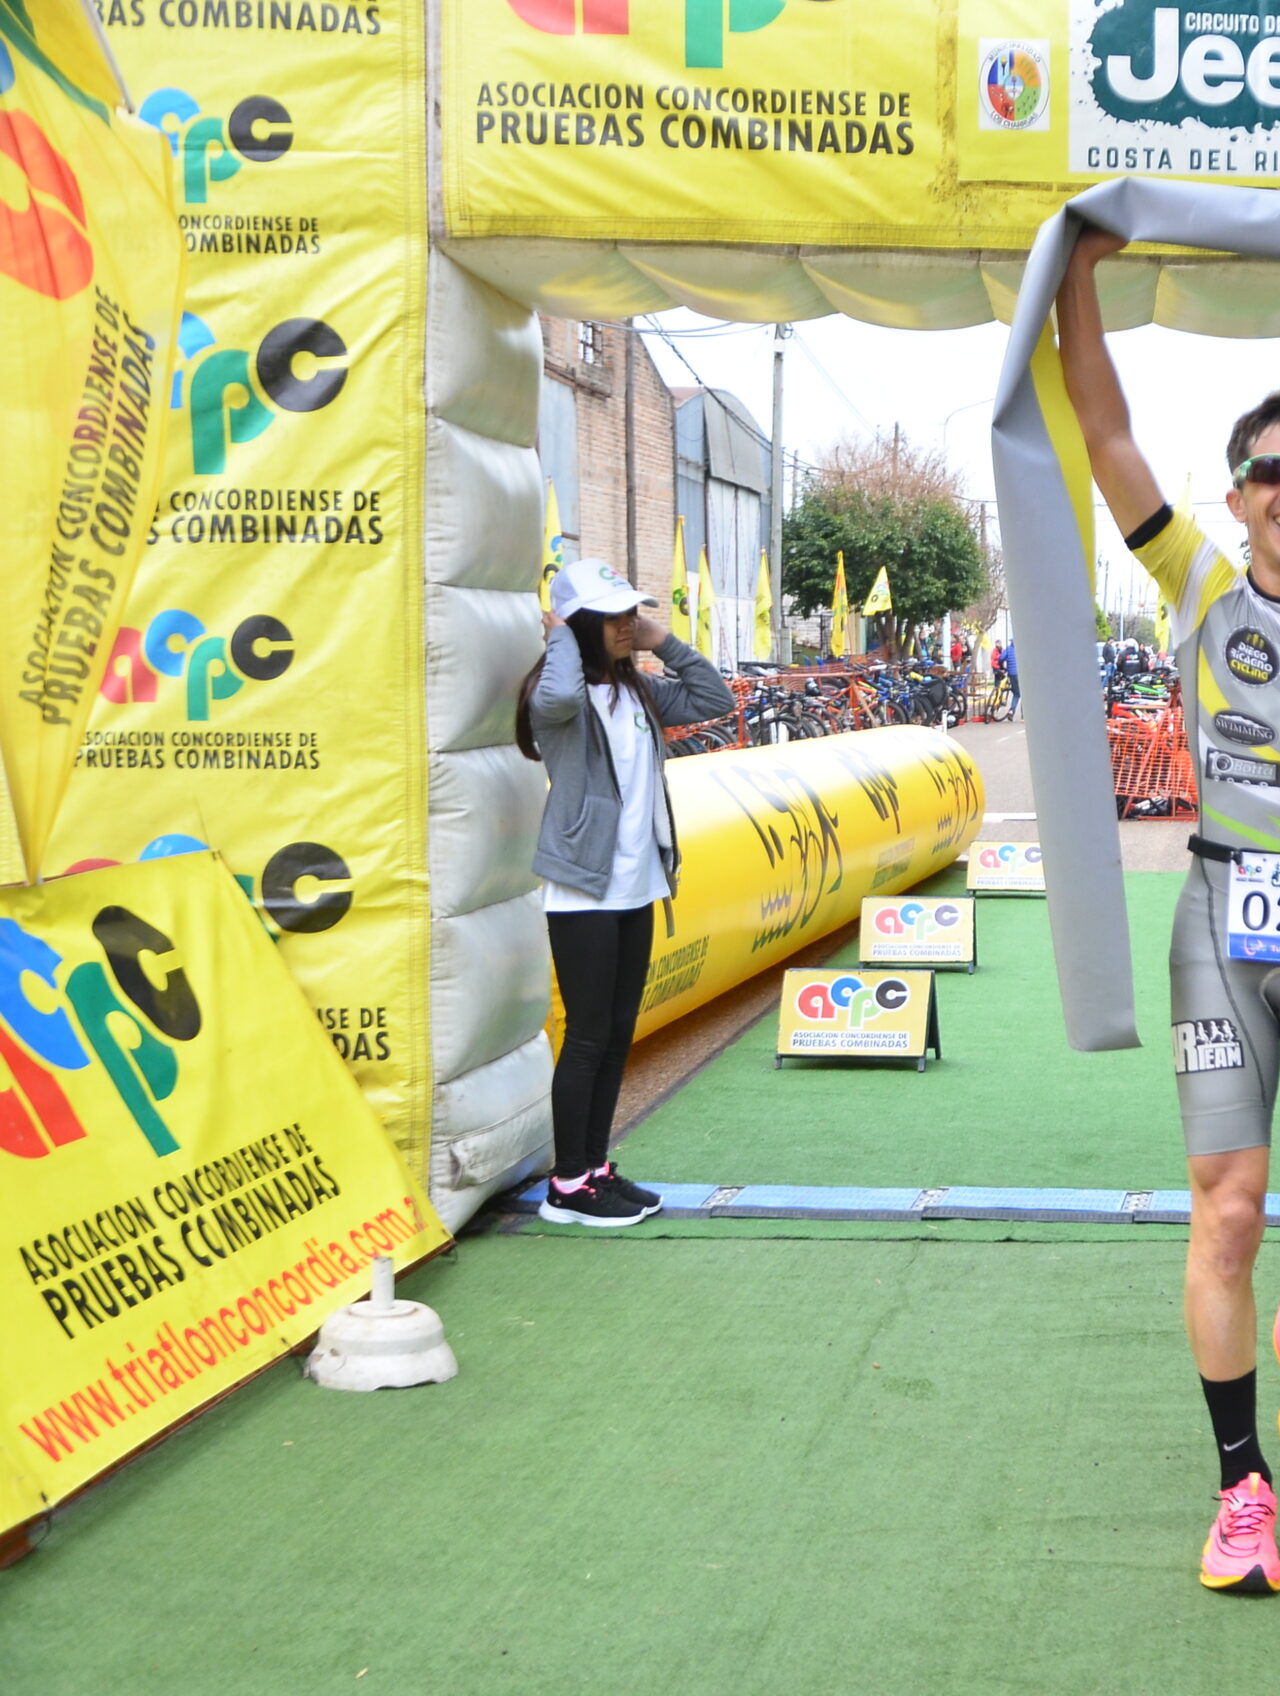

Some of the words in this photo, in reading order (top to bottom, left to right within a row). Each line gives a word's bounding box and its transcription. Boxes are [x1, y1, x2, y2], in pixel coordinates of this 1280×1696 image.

[159, 0, 382, 35] COMBINADAS
[1184, 11, 1259, 33] CIRCUITO
[477, 82, 644, 109] ASOCIACION
[655, 85, 867, 117] CONCORDIENSE
[879, 92, 911, 118] DE
[476, 112, 646, 147] PRUEBAS
[660, 115, 915, 156] COMBINADAS
[1087, 146, 1173, 170] COSTA
[1189, 148, 1238, 171] DEL
[178, 214, 293, 232] ONCORDIENSE
[299, 217, 319, 232] DE
[185, 234, 321, 254] OMBINADAS
[170, 488, 343, 512] CONCORDIENSE
[353, 490, 381, 512] DE
[171, 514, 384, 545] COMBINADAS
[81, 731, 165, 747] SOCIACION
[171, 731, 293, 748] CONCORDIENSE
[299, 732, 319, 748] DE
[175, 749, 320, 770] COMBINADAS
[360, 1007, 387, 1029] DE
[792, 1039, 837, 1048] PRUEBAS
[840, 1039, 908, 1049] COMBINADAS
[1197, 1042, 1242, 1070] TEAM
[18, 1196, 157, 1286] ASOCIACION
[152, 1134, 291, 1220] CONCORDIENSE
[282, 1122, 314, 1158] DE
[41, 1235, 187, 1340] PRUEBAS
[180, 1155, 341, 1267] COMBINADAS
